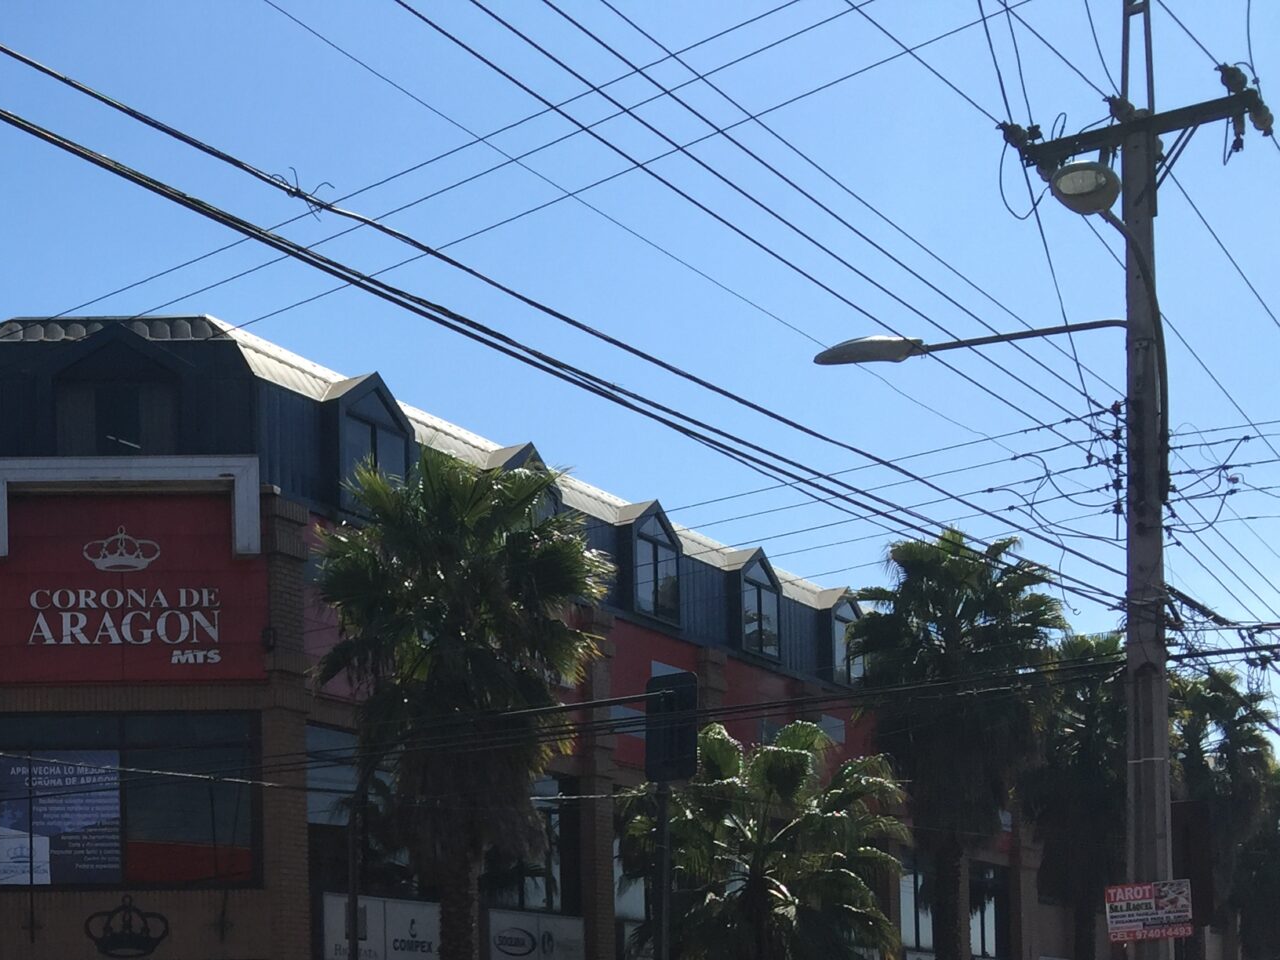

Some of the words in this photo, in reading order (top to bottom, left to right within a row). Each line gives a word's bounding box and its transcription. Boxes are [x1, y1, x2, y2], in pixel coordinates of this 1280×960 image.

[29, 587, 169, 610] CORONA
[179, 587, 221, 608] DE
[27, 609, 221, 646] ARAGON
[170, 649, 222, 665] MTS
[63, 765, 74, 775] LO
[65, 776, 77, 786] DE
[1107, 885, 1152, 902] TAROT
[392, 938, 433, 954] COMPEX
